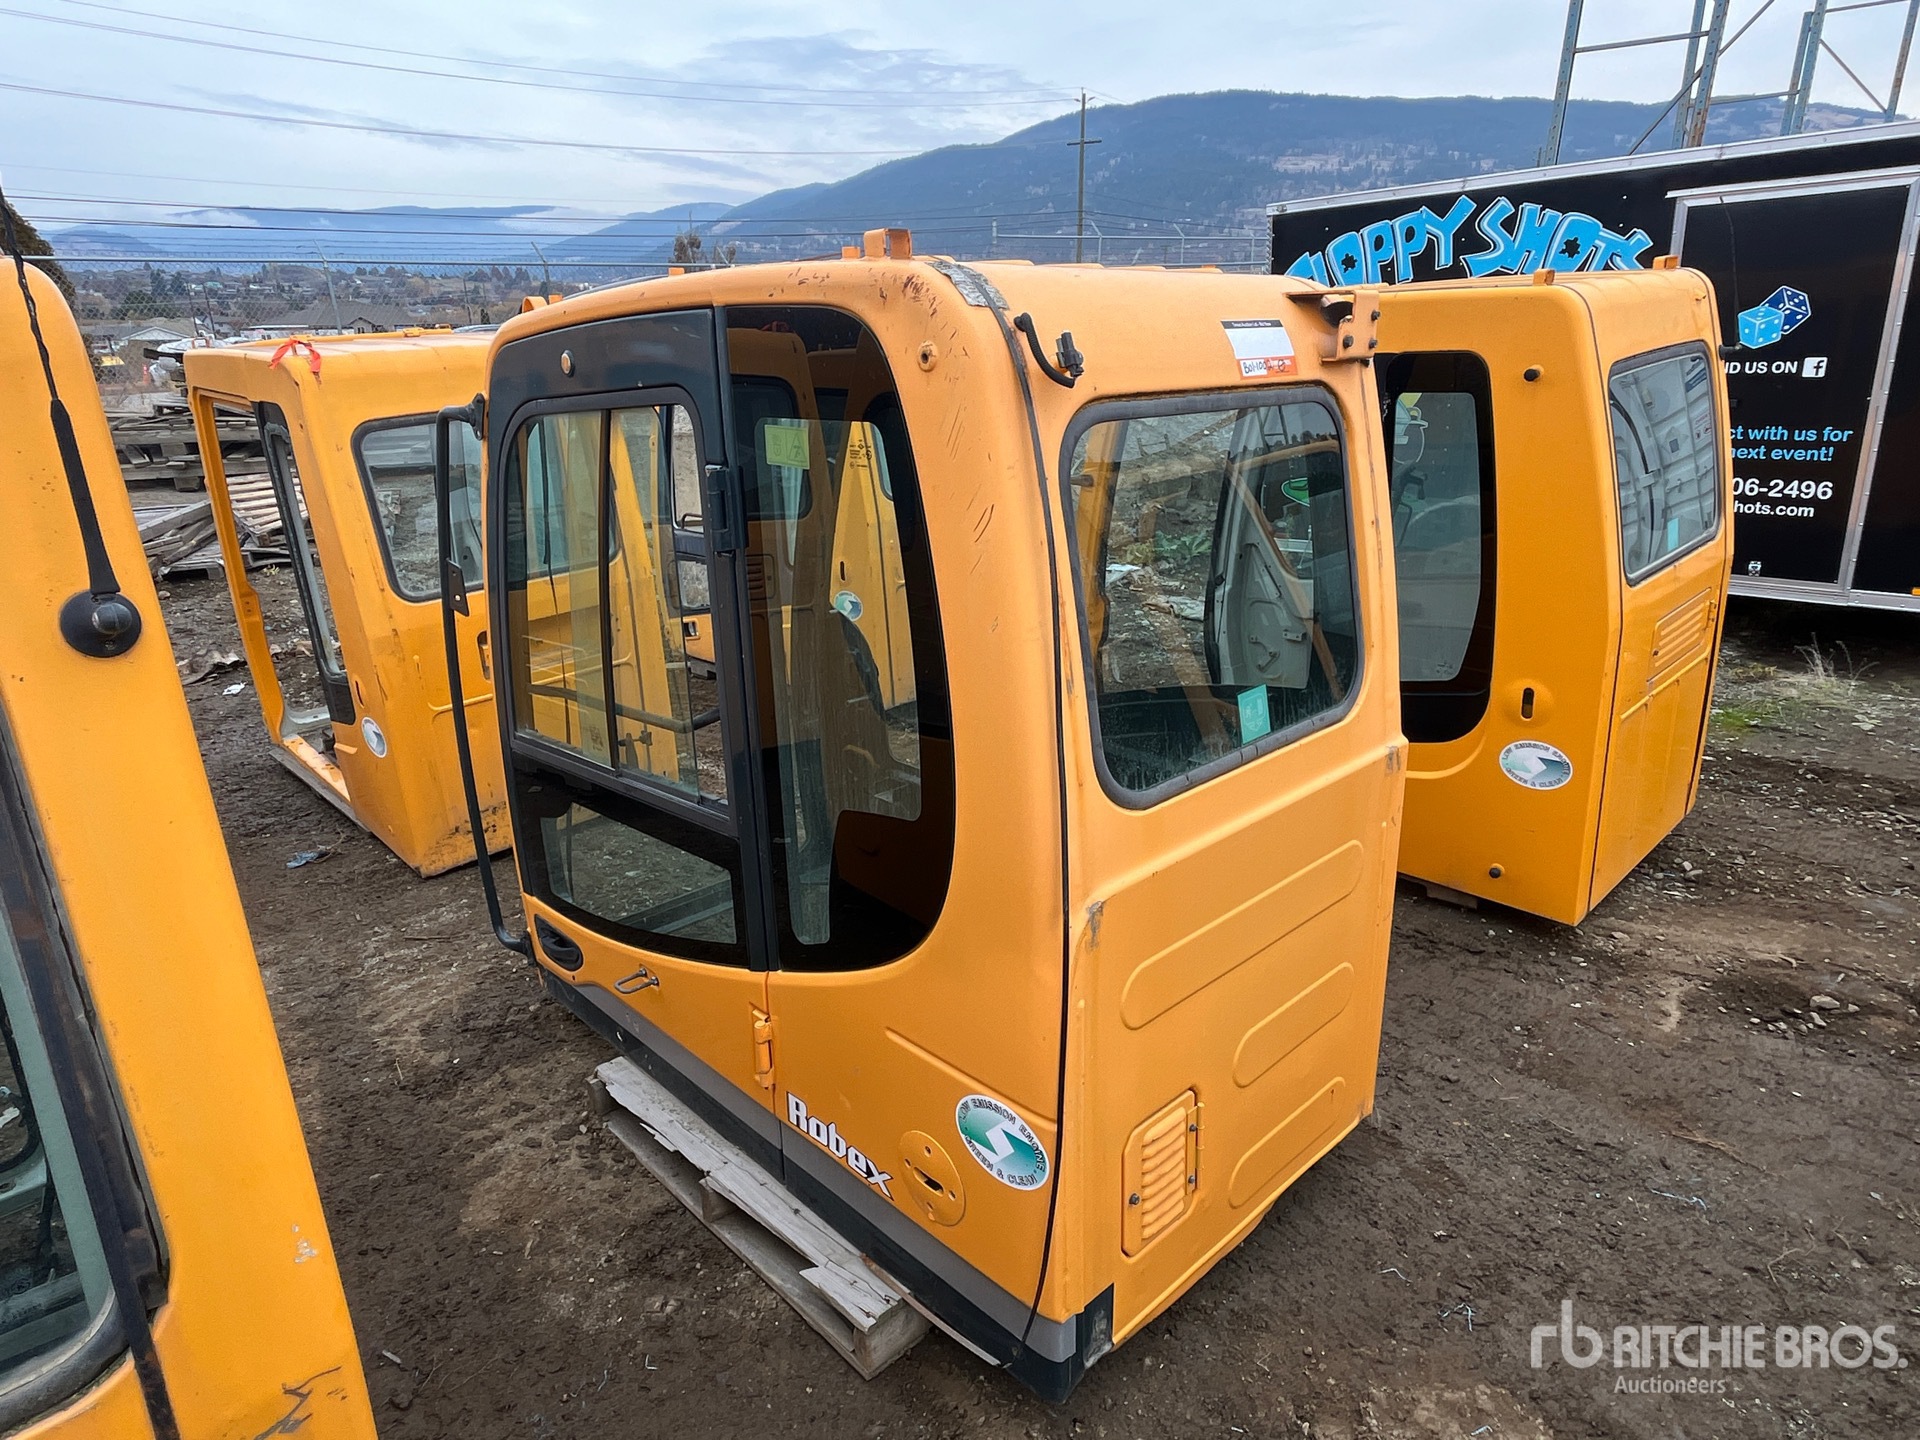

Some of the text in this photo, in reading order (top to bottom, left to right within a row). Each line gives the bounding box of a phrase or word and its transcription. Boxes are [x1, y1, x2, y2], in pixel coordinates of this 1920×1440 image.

[1284, 194, 1477, 287] OPPY
[1725, 361, 1741, 374] D
[1744, 361, 1768, 374] US
[1771, 361, 1798, 374] ON
[1748, 425, 1788, 441] with
[1793, 429, 1818, 441] us
[1822, 426, 1854, 442] for
[1770, 446, 1834, 461] event!
[1732, 477, 1834, 500] 06-2496
[1733, 500, 1815, 517] hots.com
[971, 1098, 1016, 1124] EMISSION
[1018, 1123, 1046, 1173] ENGINE
[786, 1091, 894, 1201] Robex
[1006, 1173, 1038, 1186] CLEAN
